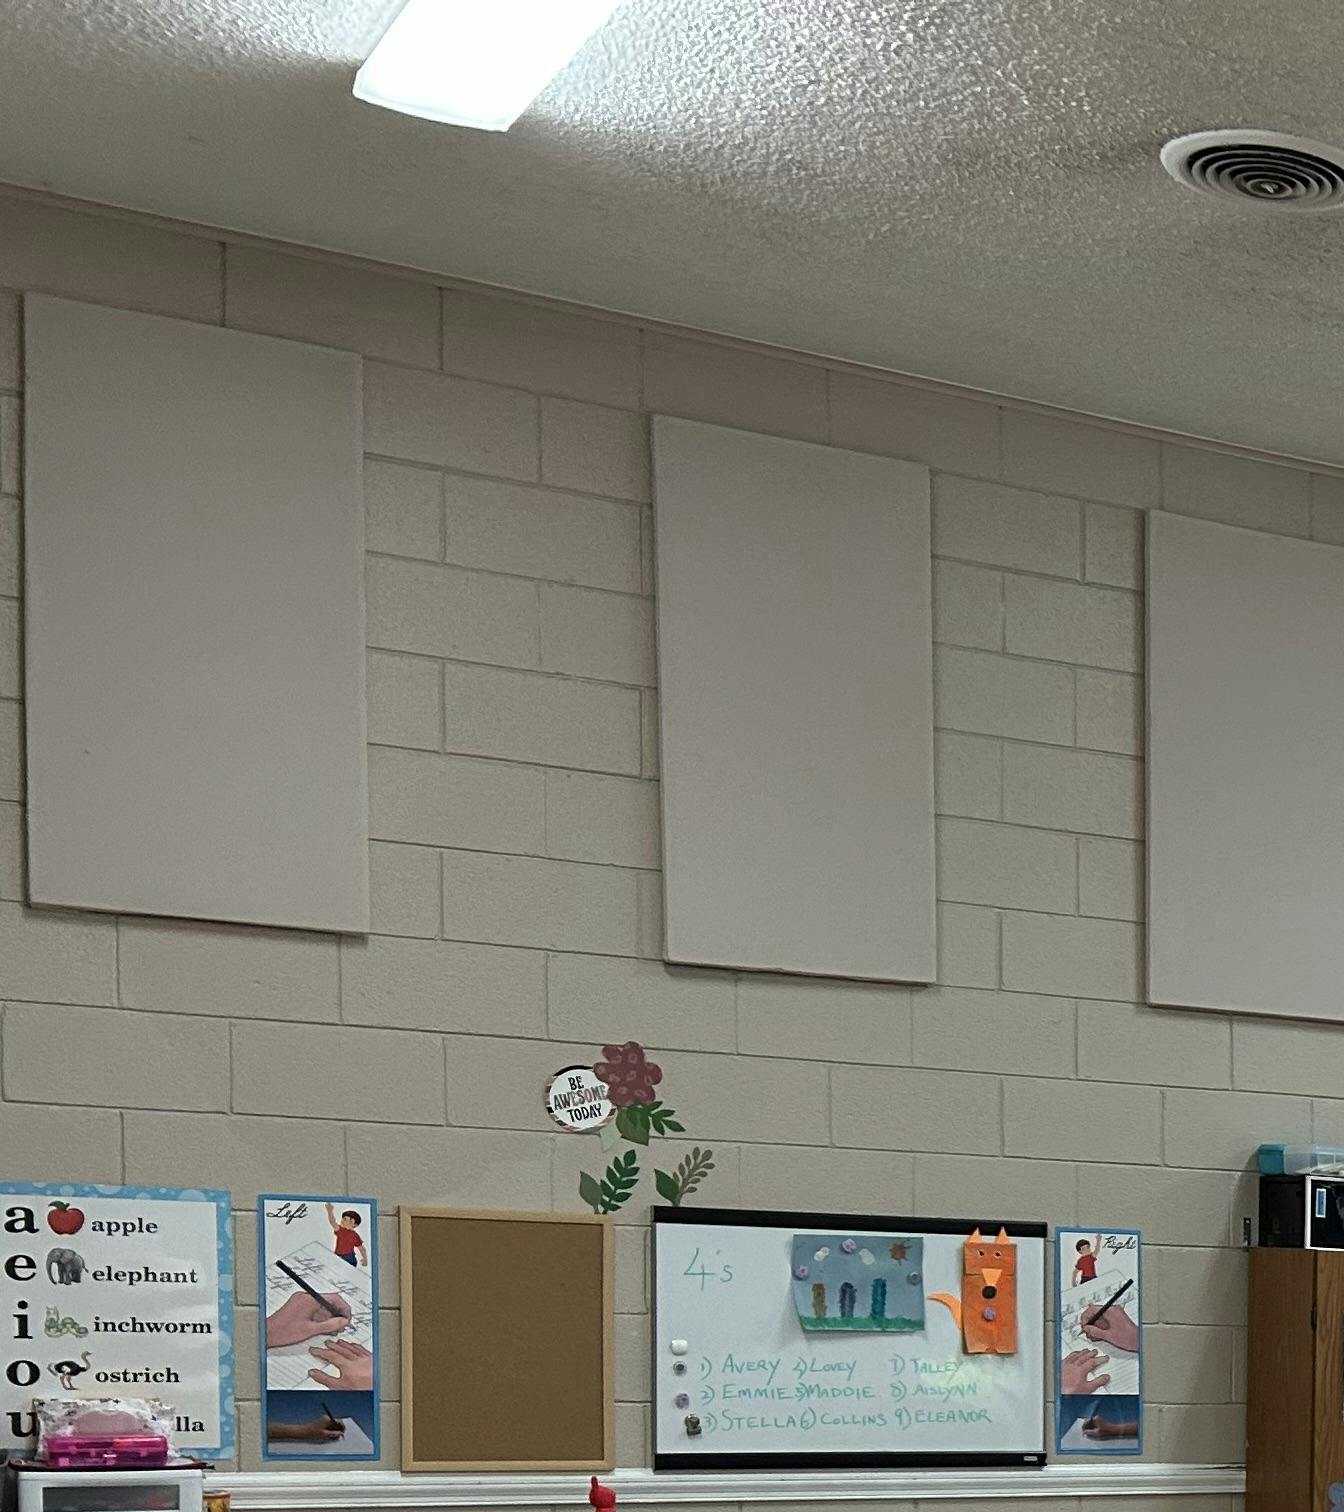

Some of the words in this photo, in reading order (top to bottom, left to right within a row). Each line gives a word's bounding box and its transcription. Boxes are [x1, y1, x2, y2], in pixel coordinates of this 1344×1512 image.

[567, 1075, 585, 1091] BE
[553, 1084, 609, 1111] AWESOME
[567, 1102, 602, 1122] TODAY
[3, 1206, 41, 1234] a
[91, 1217, 159, 1237] apple
[266, 1202, 309, 1225] Left
[1102, 1235, 1137, 1256] Right
[3, 1254, 37, 1281] e
[91, 1265, 198, 1286] elephant
[13, 1300, 33, 1340] i
[93, 1315, 213, 1334] inchworm
[5, 1359, 41, 1387] o
[95, 1367, 181, 1384] ostrich
[721, 1353, 781, 1386] AVERY
[809, 1359, 857, 1382] LOVEY
[721, 1385, 794, 1401] EMMIE
[806, 1383, 877, 1400] MADDIE
[5, 1411, 39, 1438] u
[719, 1408, 797, 1432] STELLA
[820, 1411, 889, 1428] COLLINS
[914, 1408, 994, 1425] ELEANOR
